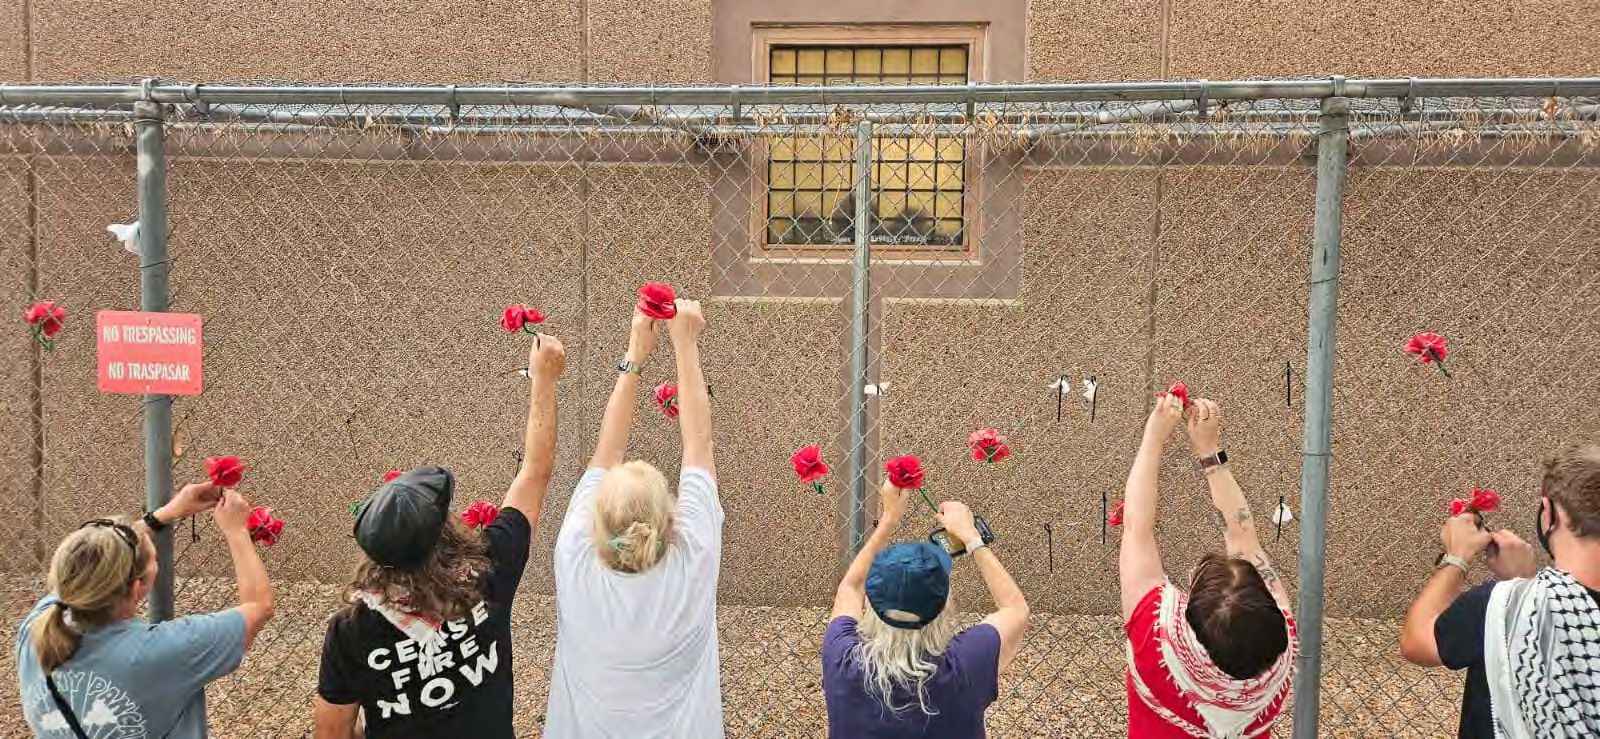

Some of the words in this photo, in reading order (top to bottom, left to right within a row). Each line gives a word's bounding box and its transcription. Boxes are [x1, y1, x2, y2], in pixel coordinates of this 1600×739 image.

[102, 325, 119, 343] NO
[122, 325, 196, 344] TRESPASSING
[108, 362, 124, 379] NO
[127, 363, 190, 381] TRASPASAR
[376, 640, 499, 719] NOW
